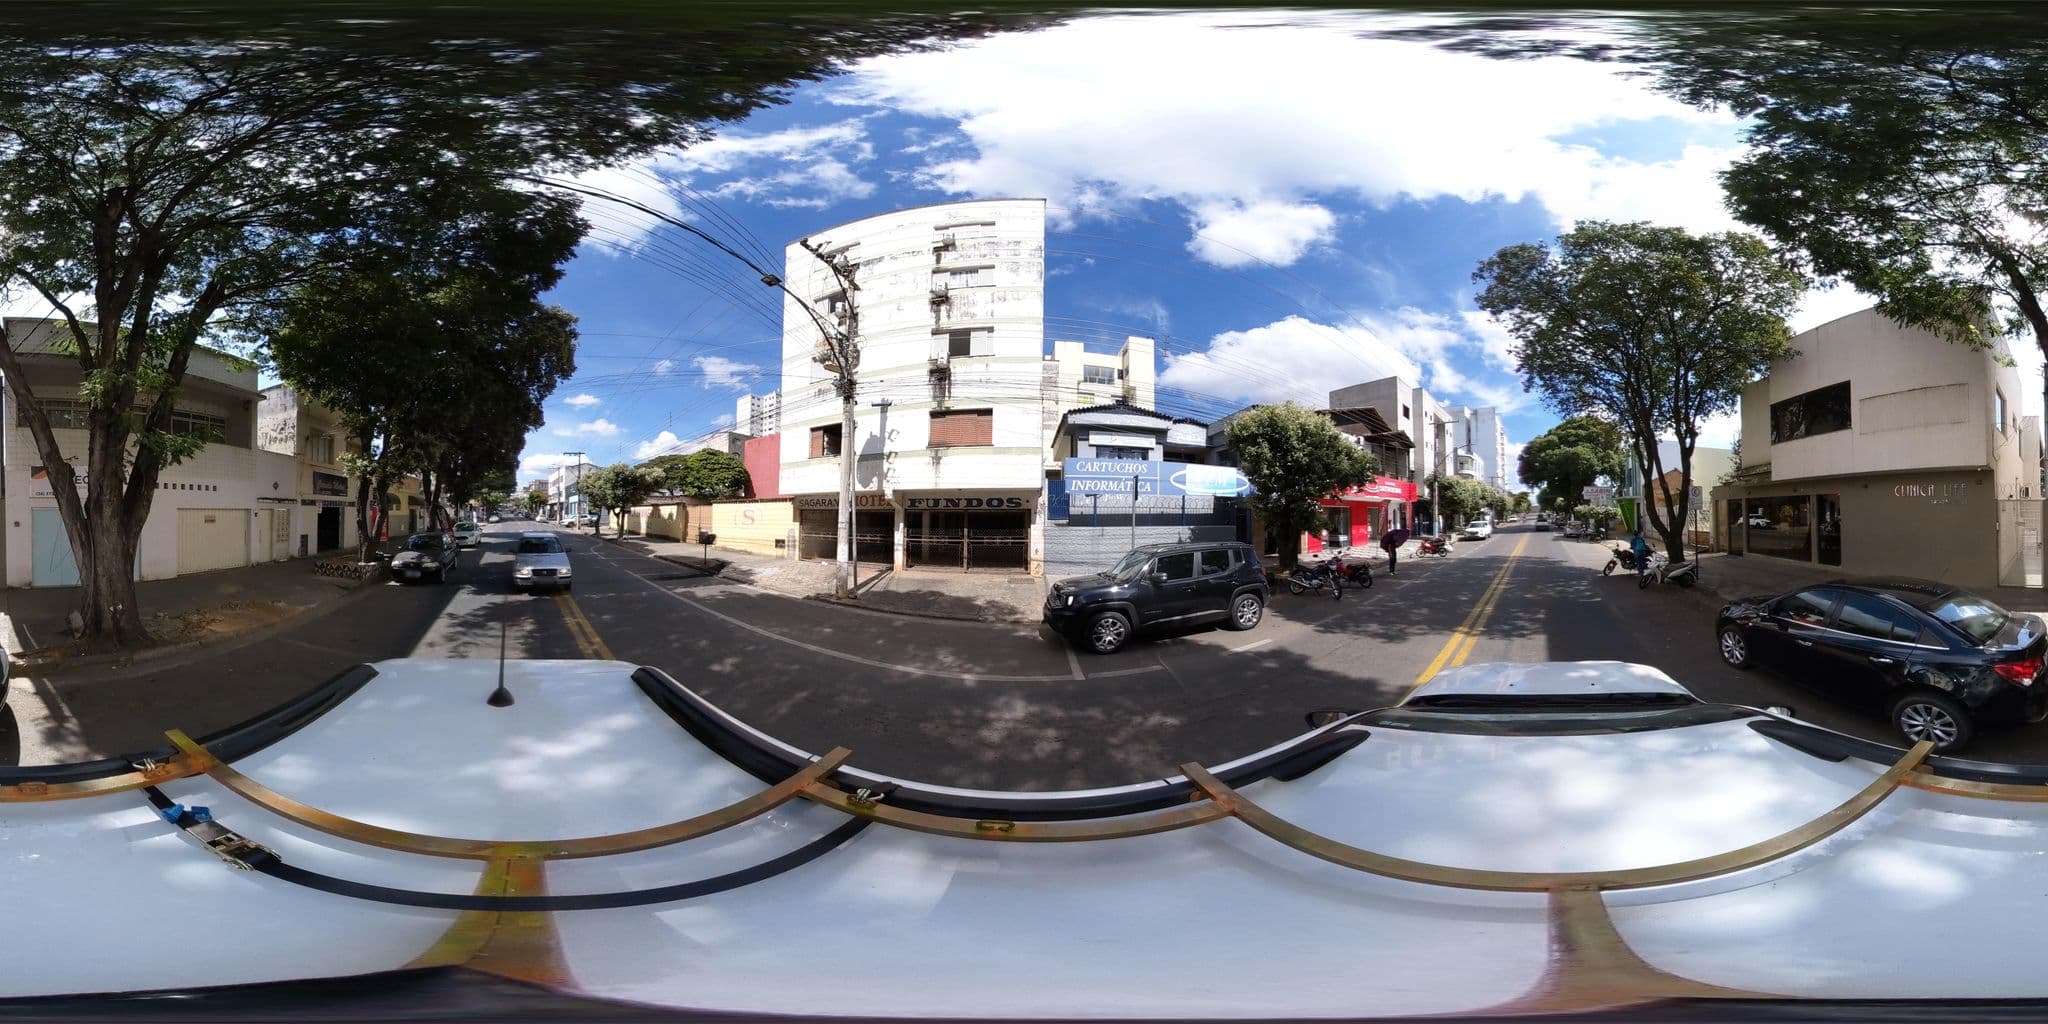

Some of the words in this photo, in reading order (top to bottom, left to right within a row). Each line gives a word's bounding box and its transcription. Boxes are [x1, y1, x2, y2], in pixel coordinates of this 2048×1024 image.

[1076, 462, 1148, 473] CARTUCHOS
[1071, 478, 1152, 492] INFORMÁTCA
[907, 497, 1022, 508] FUNDOS
